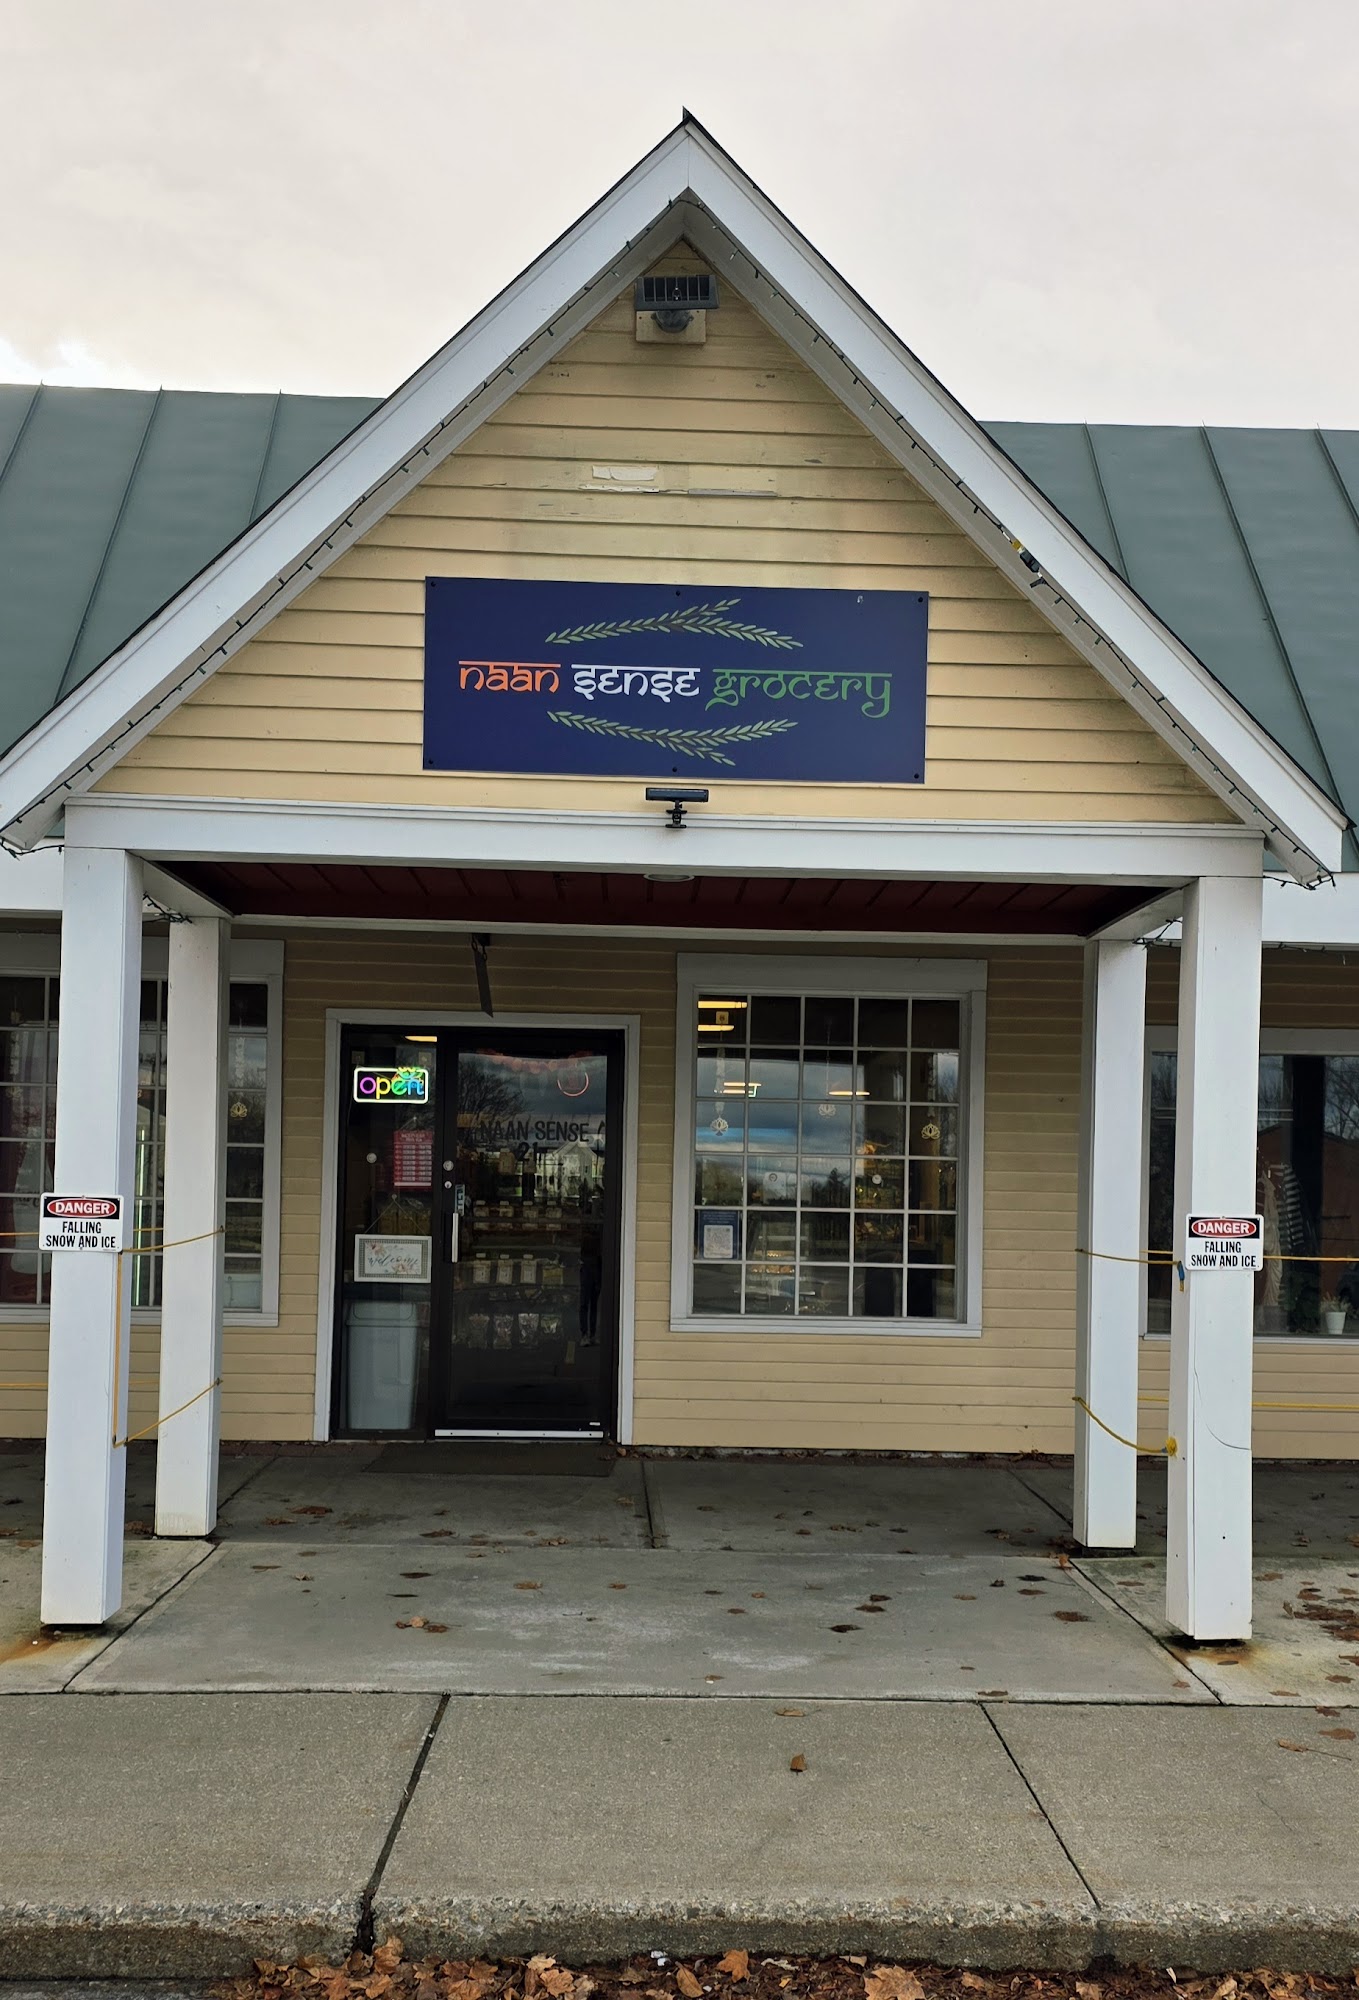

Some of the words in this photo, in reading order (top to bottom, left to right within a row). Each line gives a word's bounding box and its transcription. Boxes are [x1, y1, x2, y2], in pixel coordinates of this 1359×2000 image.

[458, 660, 561, 693] naan
[571, 664, 700, 703] sense
[705, 668, 892, 718] grocery
[360, 1077, 424, 1100] open
[481, 1120, 529, 1141] NAAN
[534, 1121, 590, 1142] SENSE
[55, 1202, 110, 1214] DANGER
[62, 1221, 102, 1234] FALLING
[1197, 1222, 1250, 1234] DANGER
[46, 1235, 75, 1247] SNOW
[78, 1235, 98, 1248] AND
[101, 1236, 116, 1248] ICE
[1204, 1241, 1242, 1253] FALLING
[1191, 1255, 1217, 1267] SNOW
[1219, 1255, 1238, 1267] AND
[1241, 1255, 1257, 1268] ICE
